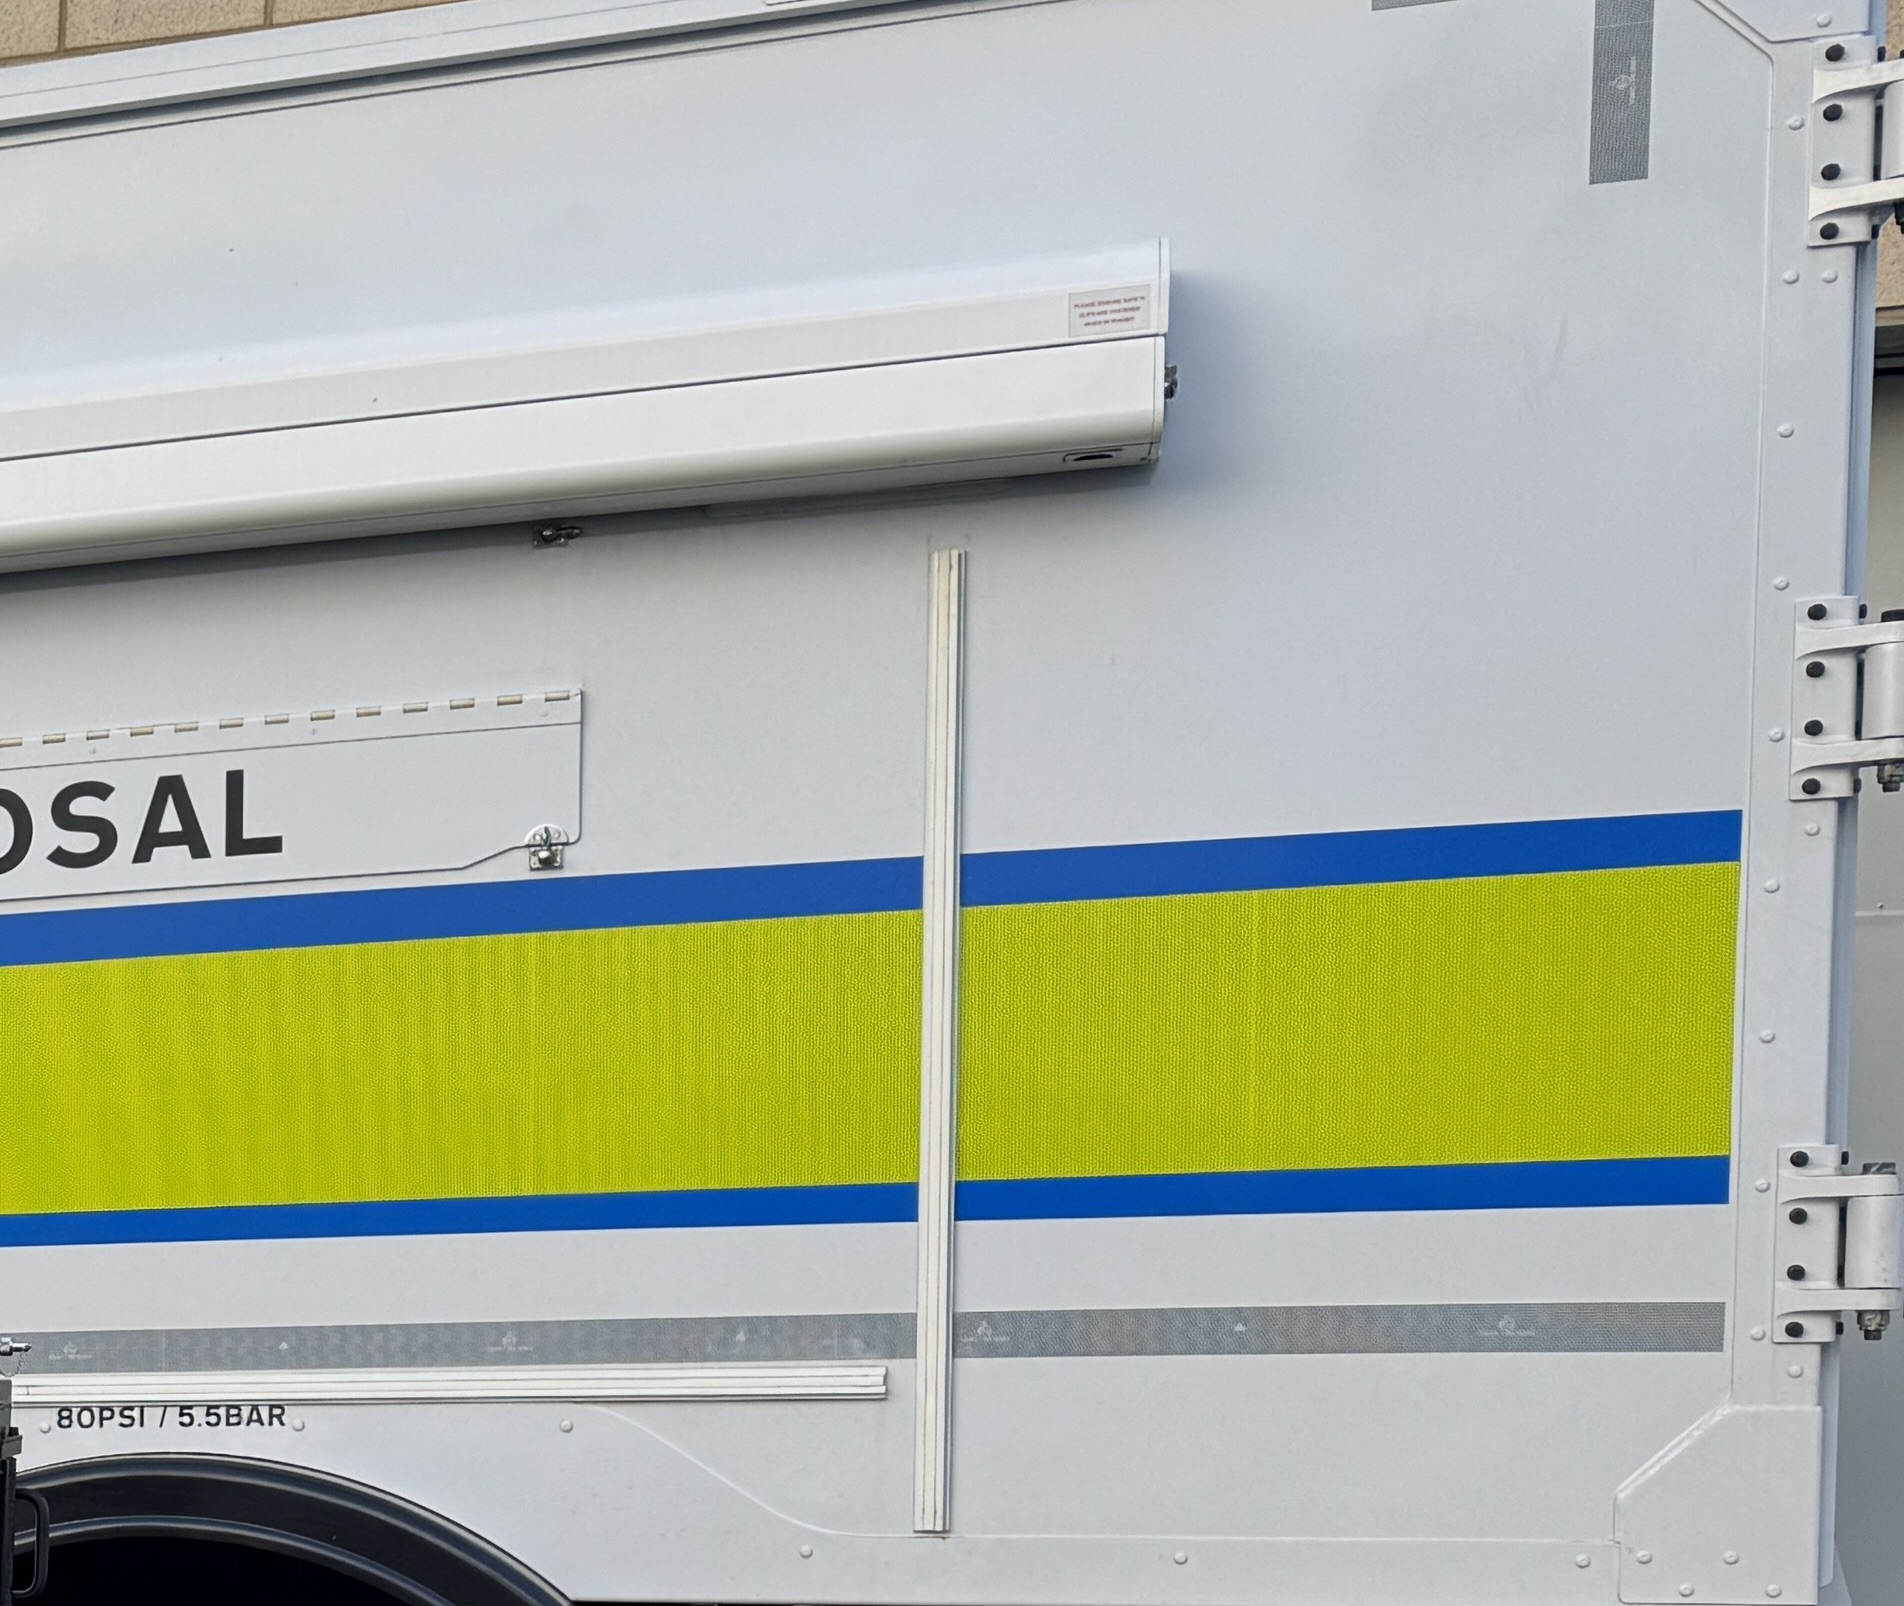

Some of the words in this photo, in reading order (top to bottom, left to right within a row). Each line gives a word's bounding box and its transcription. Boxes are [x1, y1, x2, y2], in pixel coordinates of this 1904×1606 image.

[57, 1407, 144, 1429] 80PSI
[159, 1405, 167, 1428] /
[178, 1405, 286, 1428] 5.5BAR
